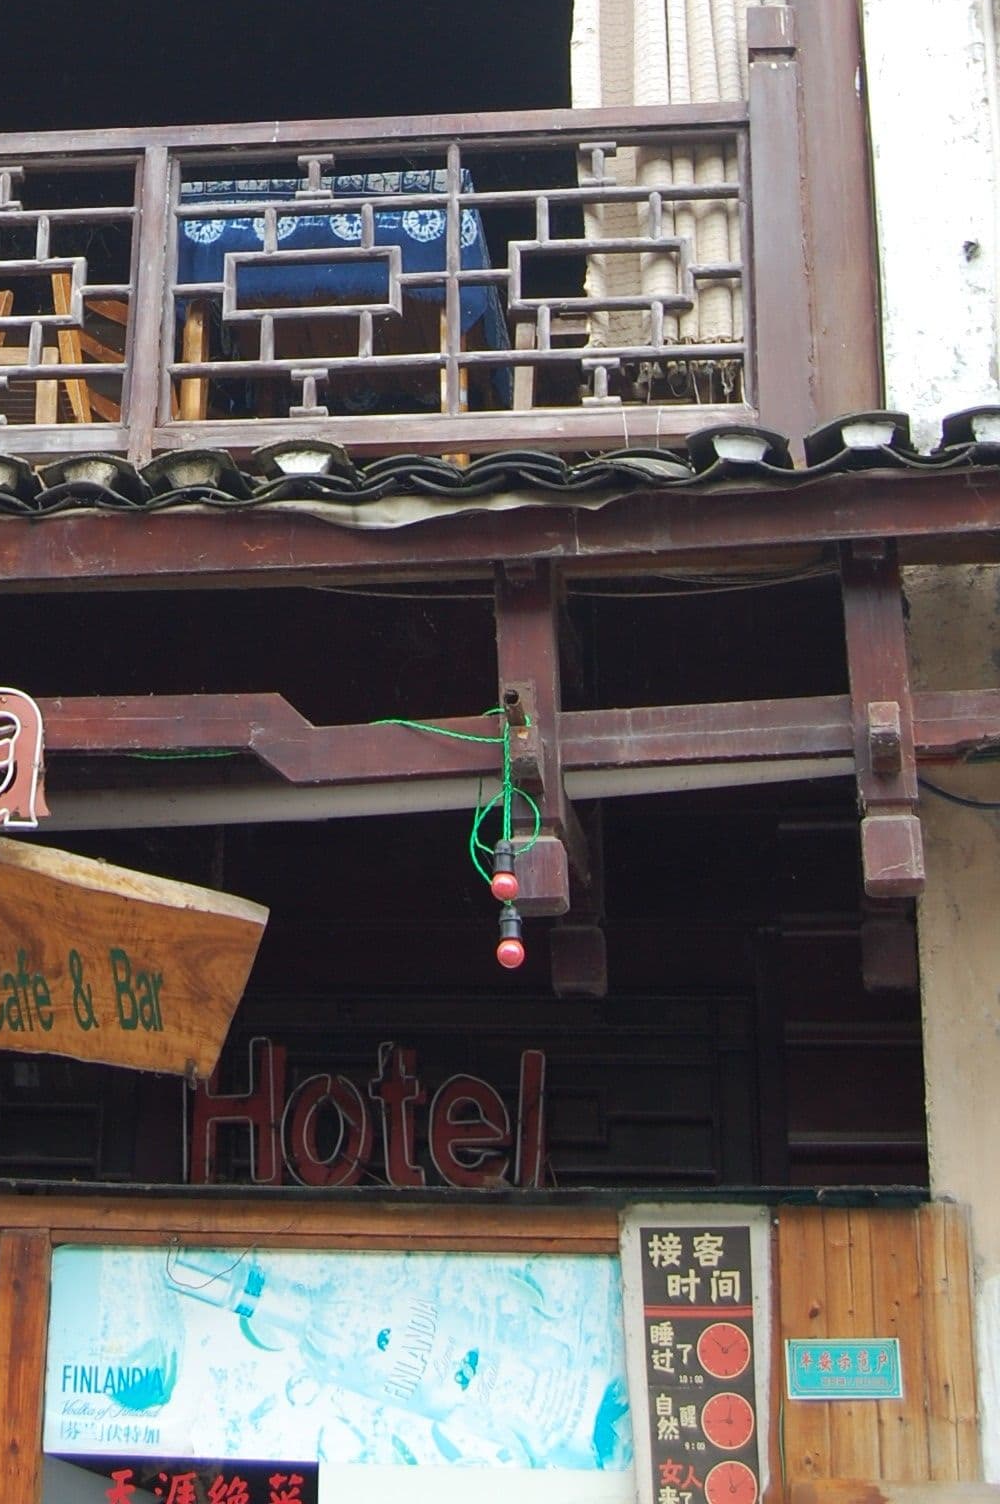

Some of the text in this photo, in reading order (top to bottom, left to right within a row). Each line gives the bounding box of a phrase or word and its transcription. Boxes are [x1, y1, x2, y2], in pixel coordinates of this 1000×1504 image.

[69, 948, 99, 1032] &
[108, 947, 165, 1033] Bar
[183, 1037, 547, 1188] Hotel
[648, 1232, 724, 1268] 接客
[667, 1268, 741, 1304] 时间
